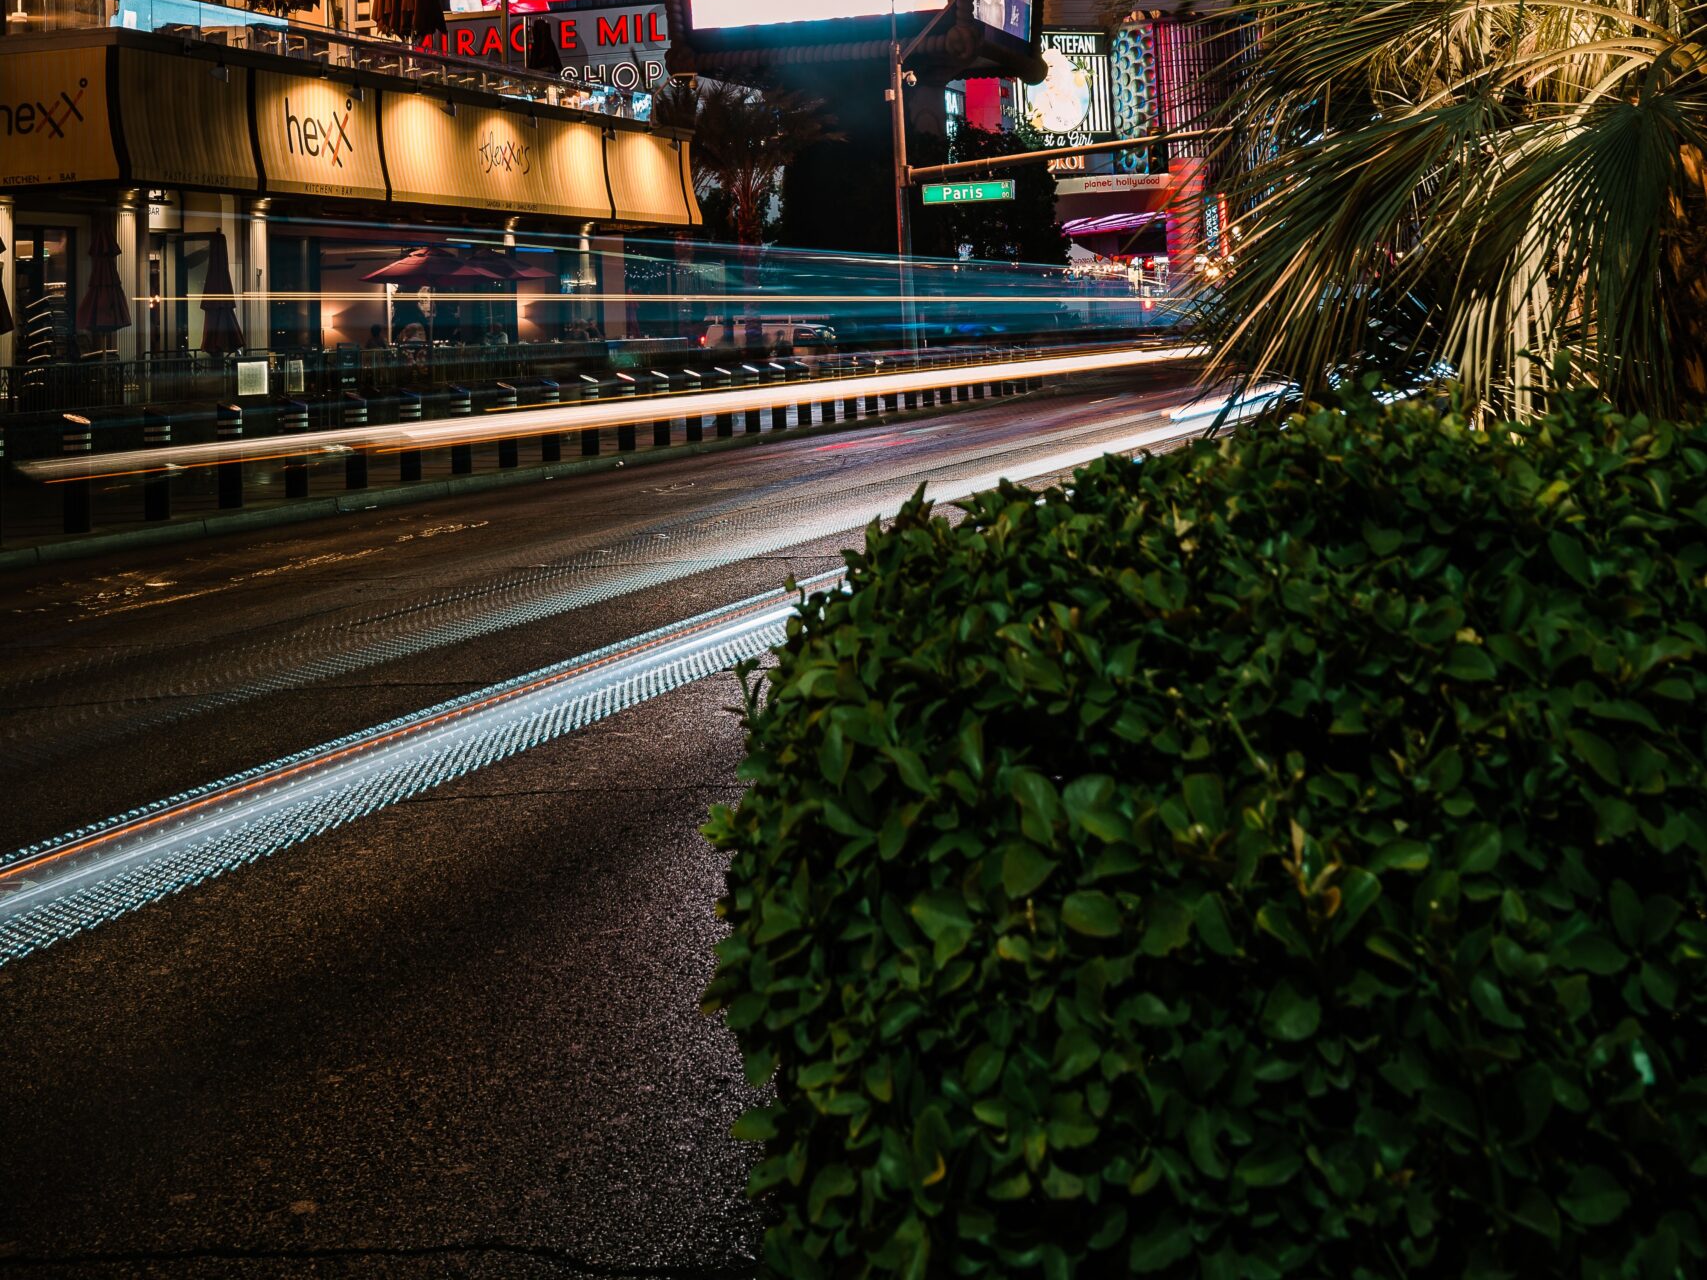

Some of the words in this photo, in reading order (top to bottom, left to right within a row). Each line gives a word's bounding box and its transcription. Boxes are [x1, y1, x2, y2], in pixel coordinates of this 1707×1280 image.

[1052, 34, 1096, 54] STEFANI
[1067, 131, 1094, 148] Girl
[3, 176, 40, 185] KITCHEN
[60, 173, 76, 182] BAR
[1084, 179, 1112, 190] planet
[1115, 176, 1160, 187] hollywood
[305, 183, 333, 194] KITCHEN
[341, 187, 353, 196] BAR
[943, 185, 983, 200] Paris
